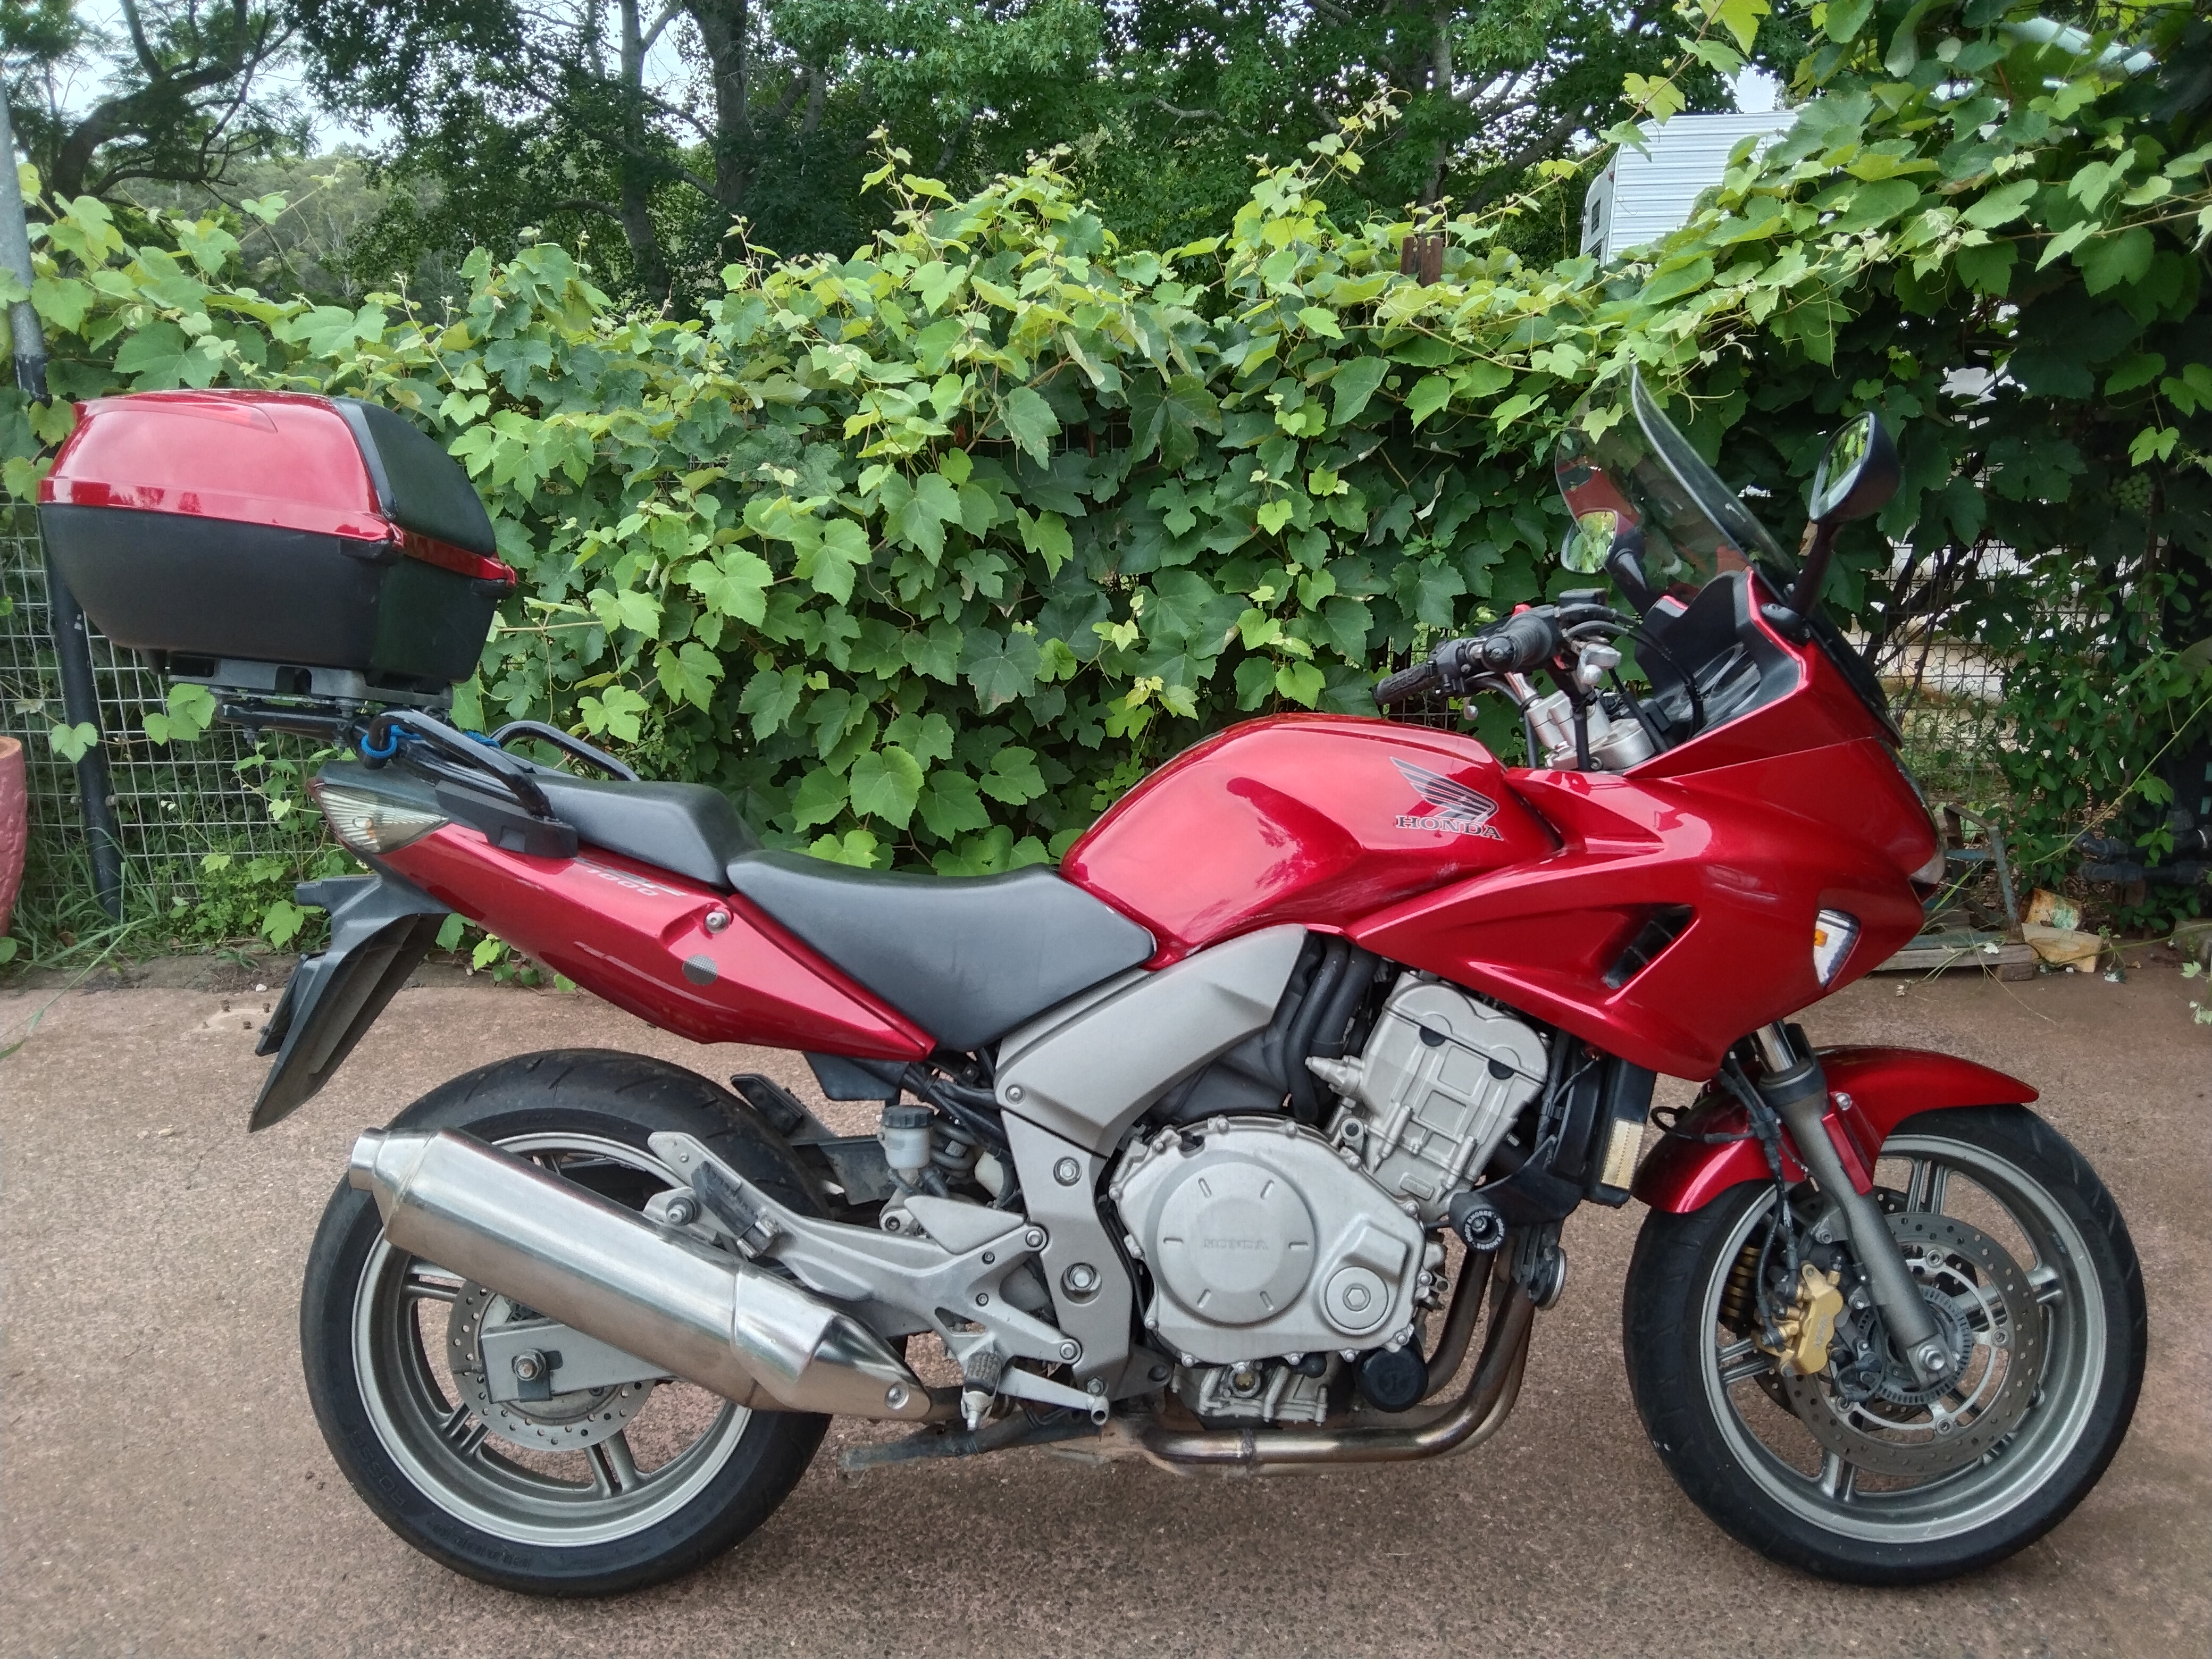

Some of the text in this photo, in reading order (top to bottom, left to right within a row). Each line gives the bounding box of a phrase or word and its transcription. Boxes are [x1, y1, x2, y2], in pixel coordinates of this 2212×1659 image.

[1396, 815, 1504, 841] HONDA
[586, 868, 659, 896] 1000
[1203, 1238, 1269, 1250] HONDA
[350, 1430, 409, 1507] ROSSO
